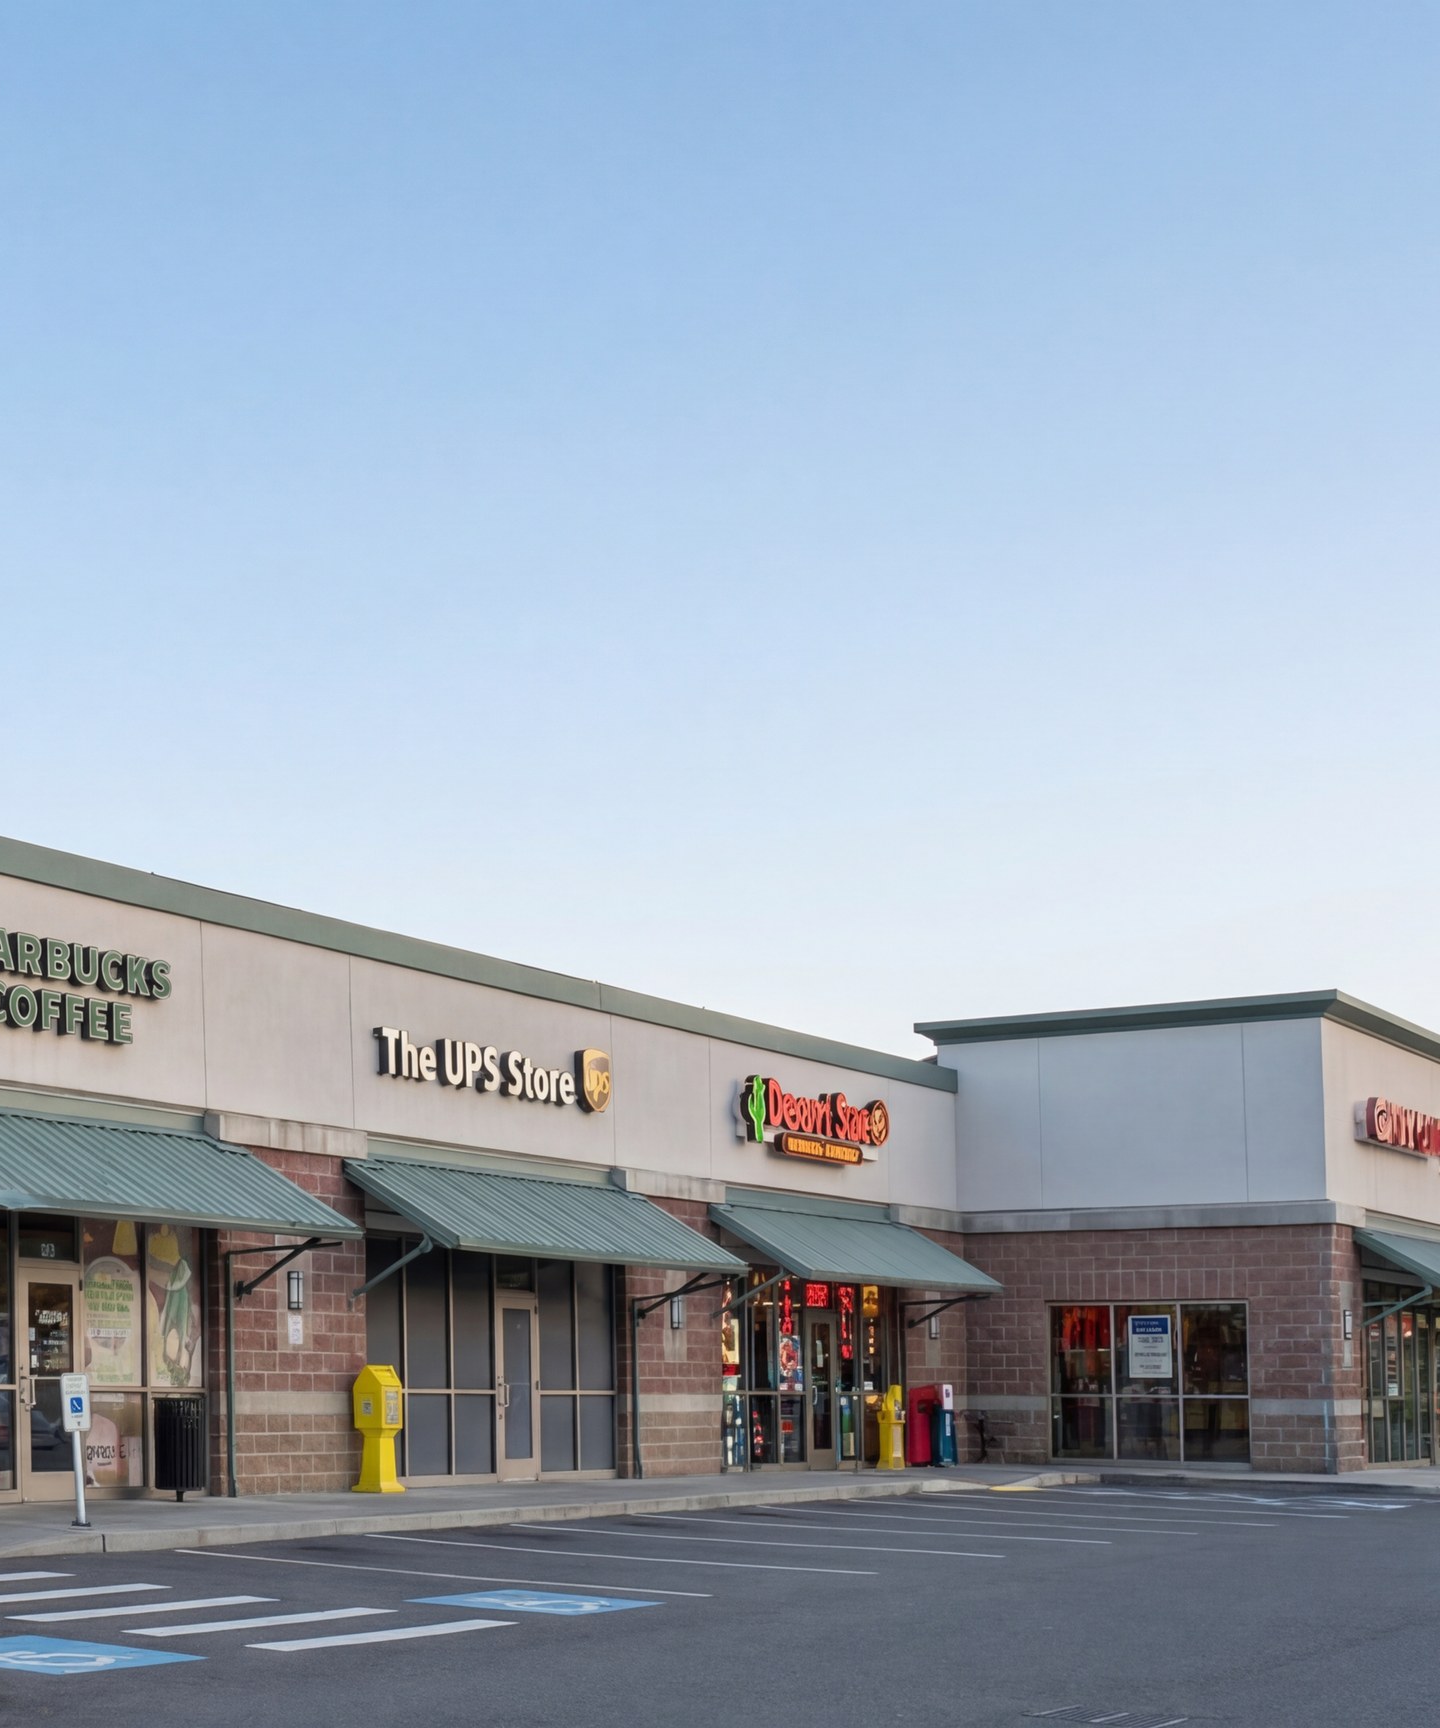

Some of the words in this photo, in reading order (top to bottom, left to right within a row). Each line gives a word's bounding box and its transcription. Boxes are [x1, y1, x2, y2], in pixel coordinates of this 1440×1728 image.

[377, 1026, 437, 1082] The
[440, 1038, 501, 1093] UPS
[504, 1050, 576, 1105] Store
